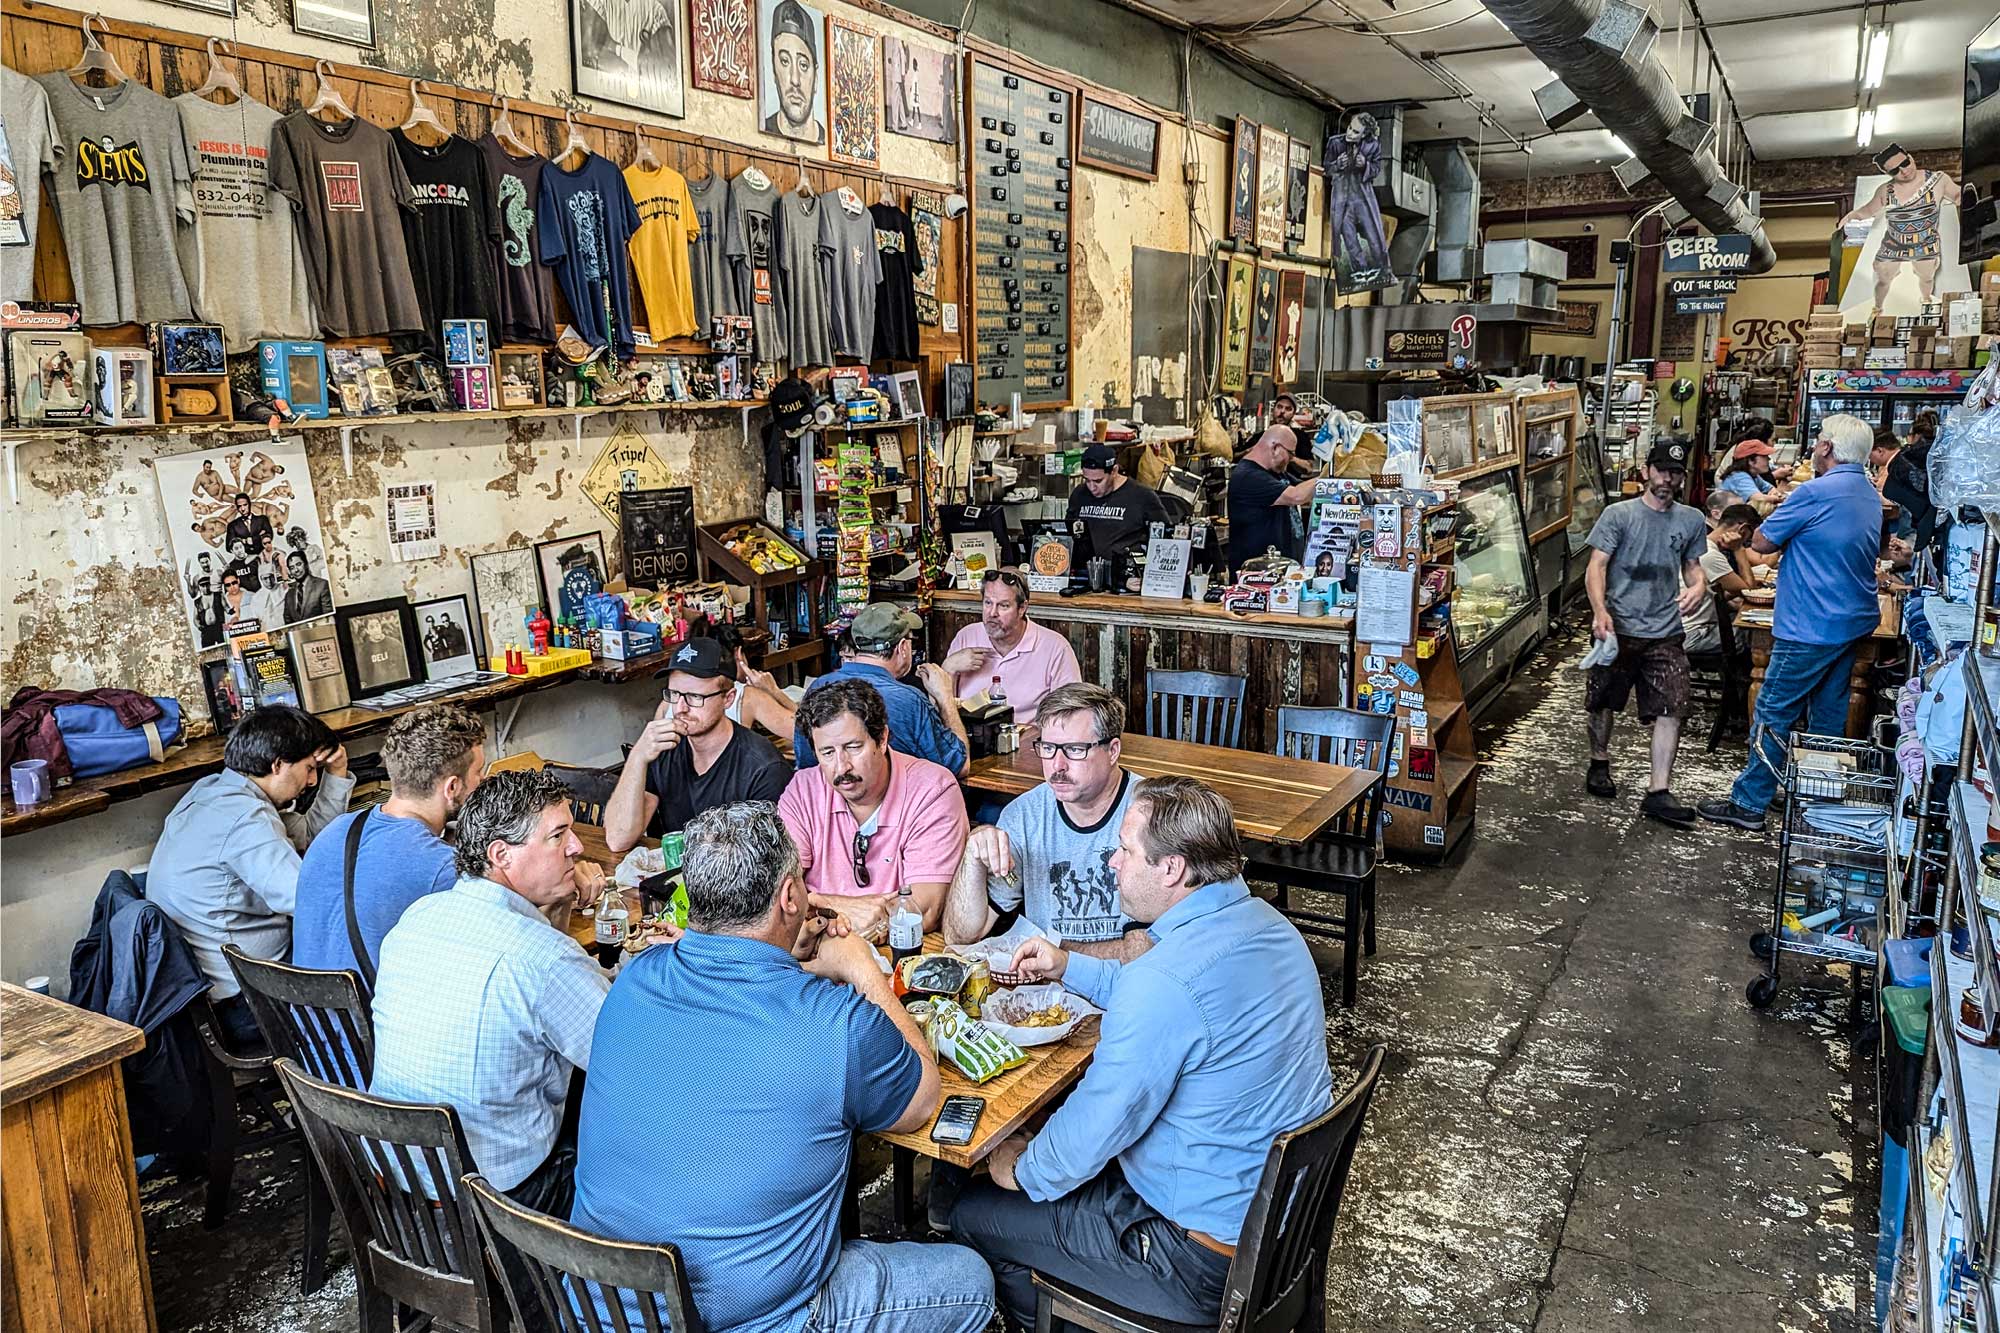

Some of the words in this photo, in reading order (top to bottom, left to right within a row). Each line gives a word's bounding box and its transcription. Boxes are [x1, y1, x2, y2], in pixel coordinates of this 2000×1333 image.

[1089, 105, 1156, 153] SANDWICHES
[199, 141, 230, 154] JESUS
[232, 143, 242, 155] IS
[201, 154, 252, 169] Plumbing
[253, 159, 268, 170] Co.
[1666, 236, 1719, 260] BEER
[1698, 252, 1750, 271] ROOM!
[1673, 280, 1696, 293] OUT
[1697, 280, 1712, 290] THE
[1713, 279, 1737, 291] BACK
[1679, 302, 1688, 310] TO
[1689, 302, 1702, 310] THE
[1702, 302, 1726, 310] RIGHT
[1406, 333, 1445, 345] Stein's
[1732, 318, 1808, 350] RES
[1845, 376, 1891, 387] COLD
[608, 442, 648, 468] Tripel
[1080, 505, 1126, 517] ANTIGRAVITY
[1325, 507, 1338, 520] New
[236, 567, 251, 576] DELI
[371, 651, 389, 663] DELI
